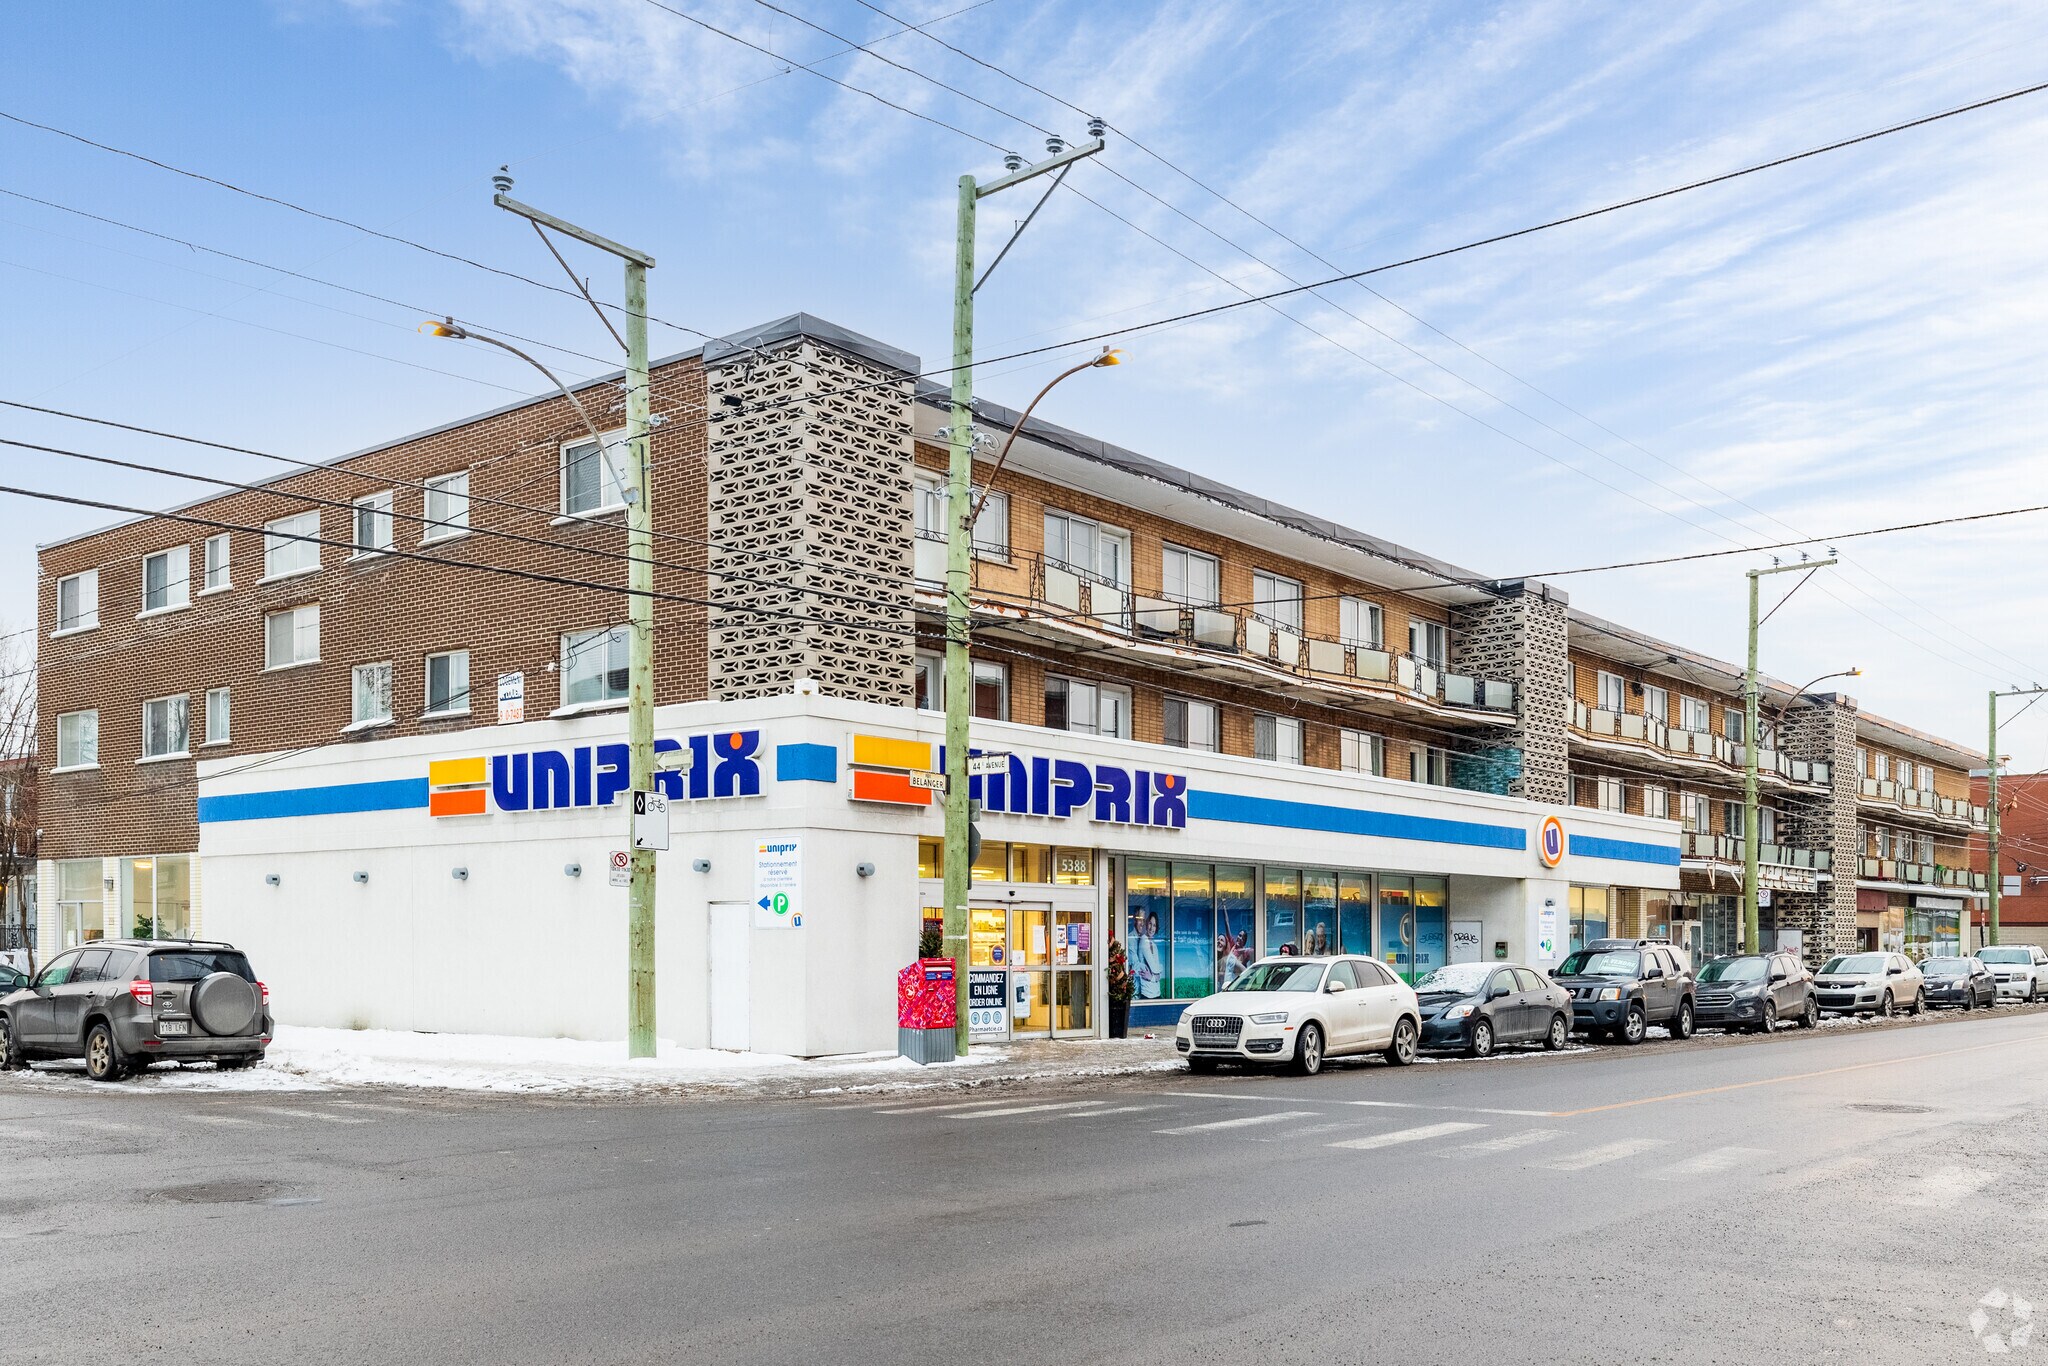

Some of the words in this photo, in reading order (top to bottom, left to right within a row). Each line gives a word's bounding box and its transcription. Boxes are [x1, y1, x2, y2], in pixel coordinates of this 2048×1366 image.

[986, 760, 1005, 769] AVENUE
[912, 776, 944, 789] BELANGER
[1061, 859, 1087, 872] 5388
[969, 973, 1004, 984] COMMANDEZ
[974, 985, 982, 996] EN
[983, 985, 999, 995] LIGNE
[969, 998, 986, 1007] ORDER
[986, 997, 1003, 1006] ONLINE
